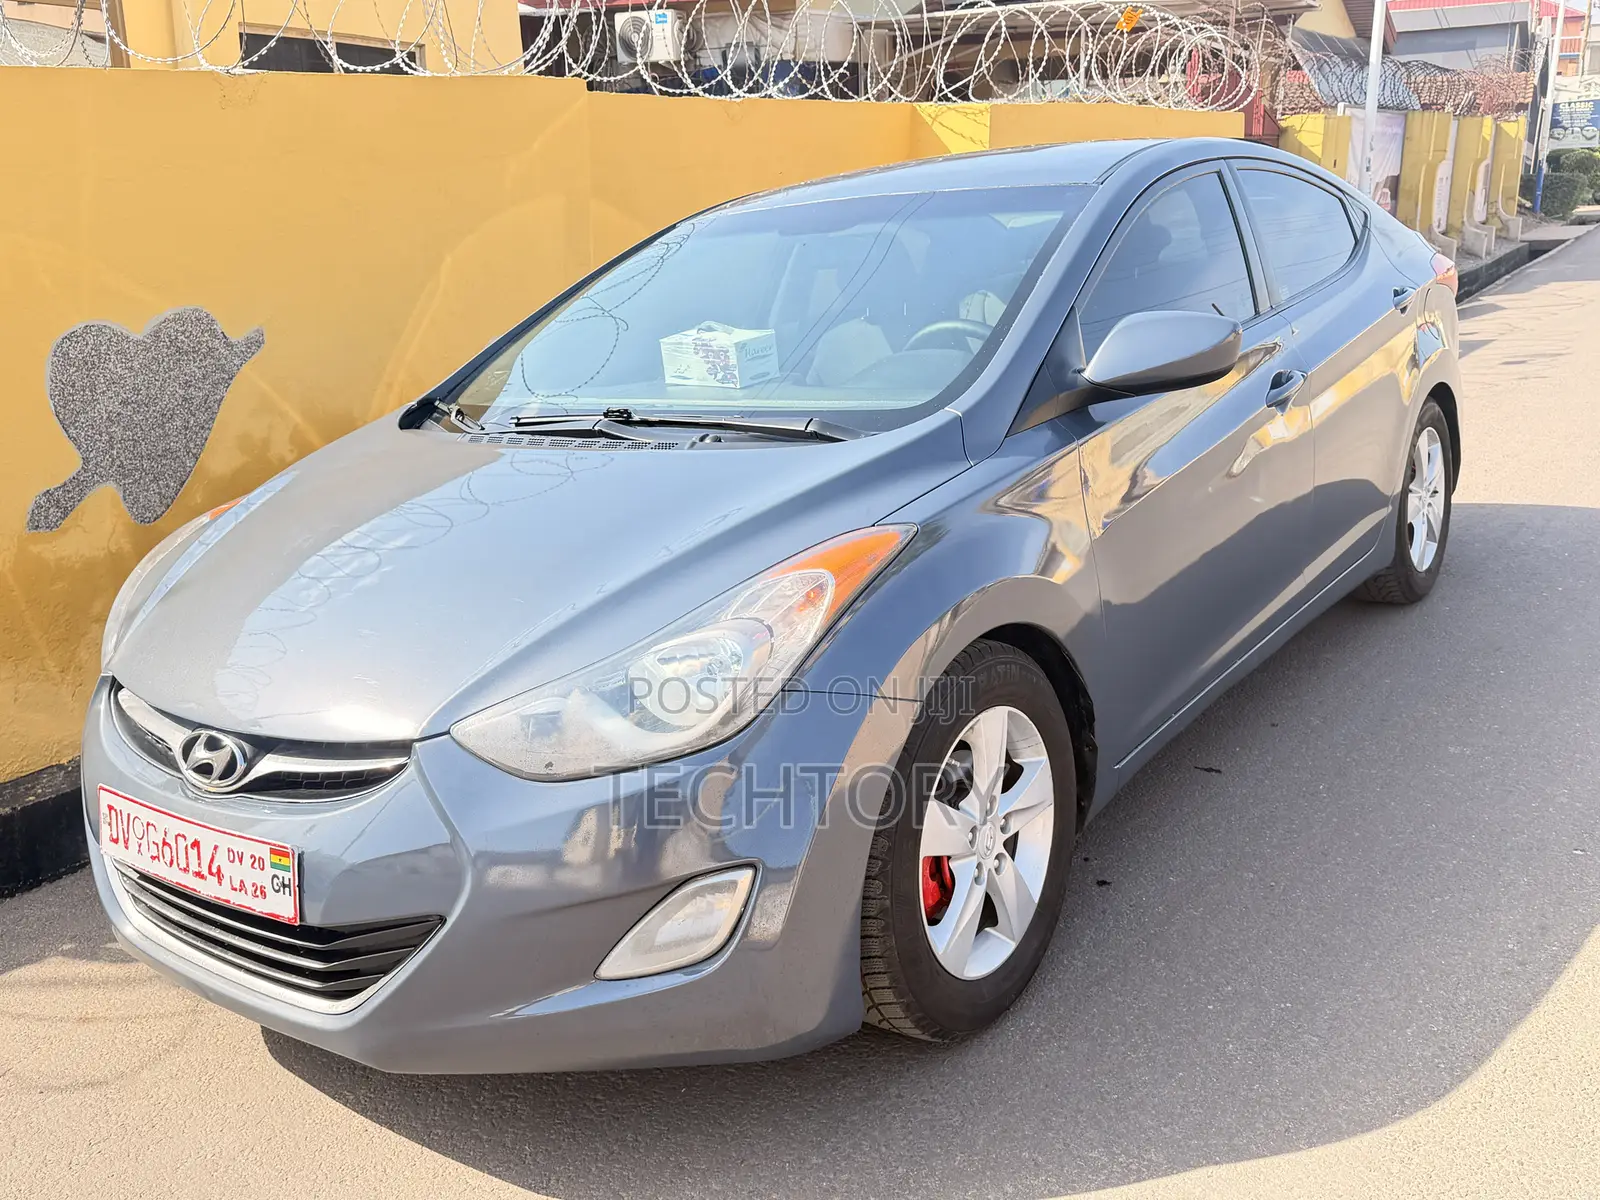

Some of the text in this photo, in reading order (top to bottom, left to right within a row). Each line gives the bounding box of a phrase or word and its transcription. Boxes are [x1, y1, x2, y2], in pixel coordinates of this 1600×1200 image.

[1559, 101, 1594, 109] CLASSIC
[227, 847, 265, 871] DV 20
[251, 881, 267, 900] 26
[271, 873, 292, 897] GH
